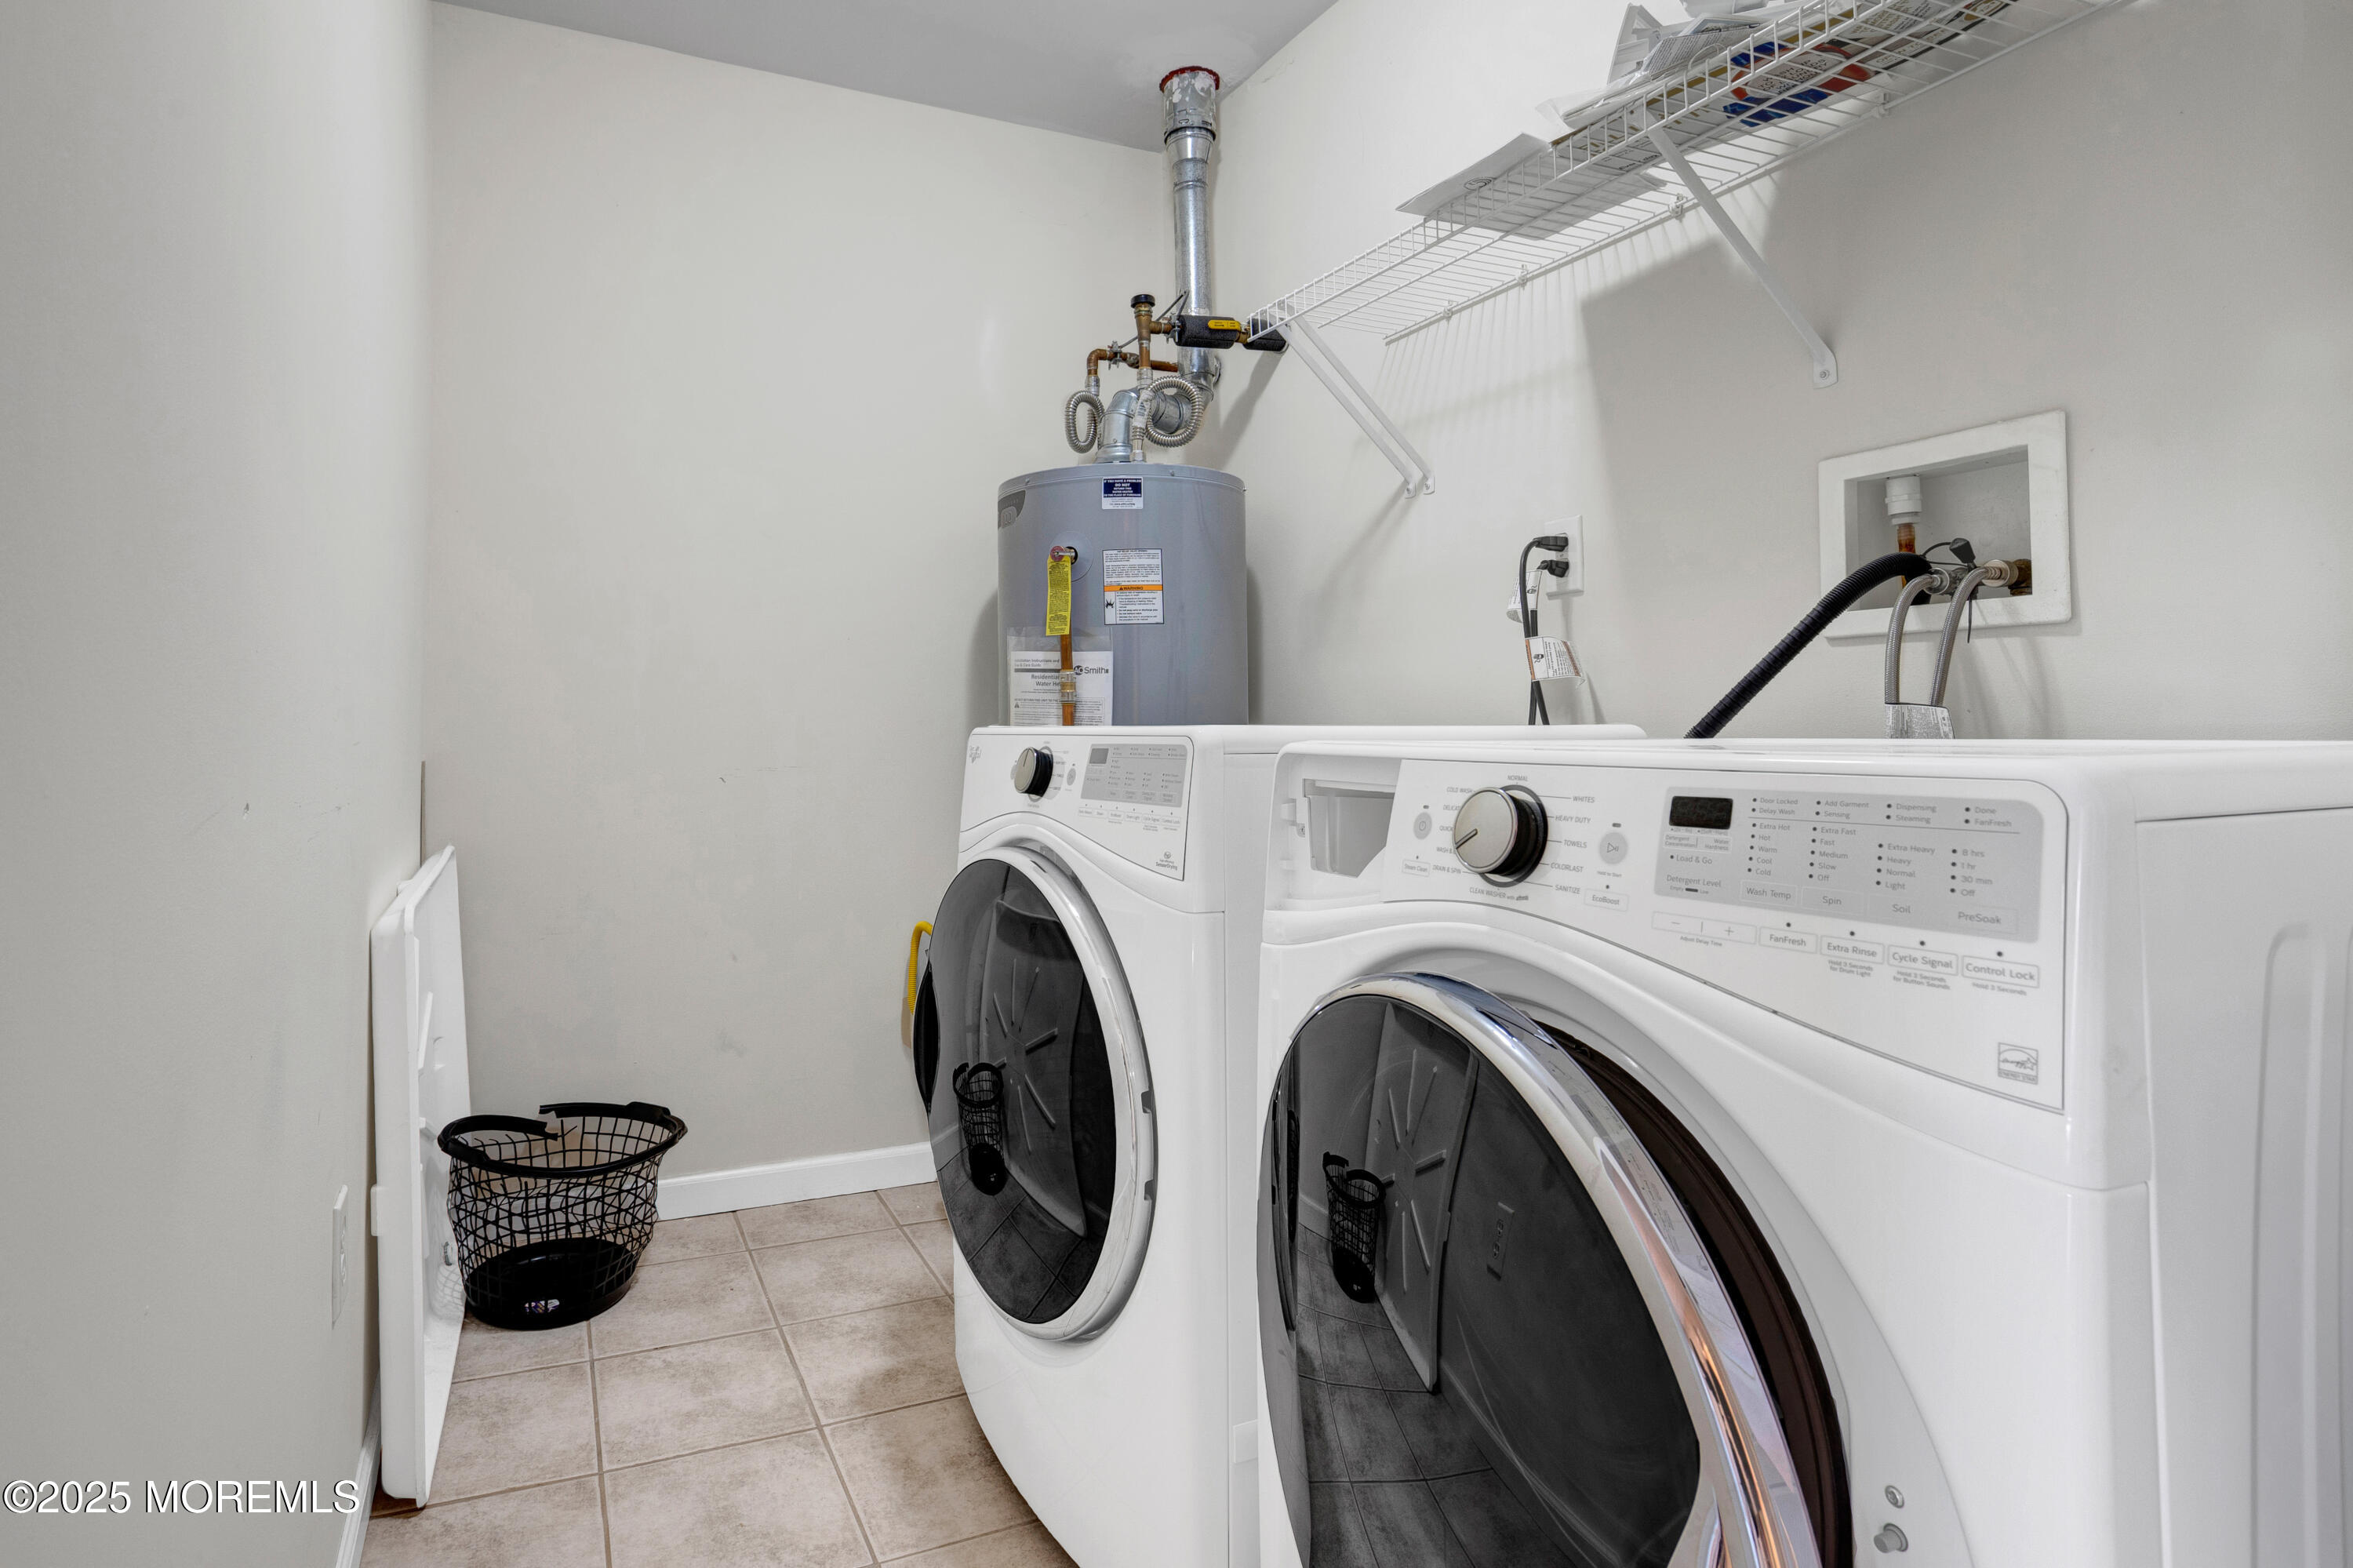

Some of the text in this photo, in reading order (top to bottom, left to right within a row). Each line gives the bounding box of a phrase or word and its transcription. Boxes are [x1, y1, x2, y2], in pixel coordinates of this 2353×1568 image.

[1789, 59, 1826, 75] LODS
[1896, 803, 1937, 813] Dispensing
[1824, 811, 1850, 820] Sensing
[1896, 814, 1931, 824] Steaming
[1974, 818, 2012, 827] FanFresh
[1564, 839, 1587, 849] TOWELS
[1887, 843, 1936, 855] Extra Heavy
[1886, 857, 1912, 866] Heavy
[1551, 862, 1584, 873] COLORLAST
[1886, 868, 1916, 878] Normal
[1667, 875, 1721, 887] Detergent Level
[1885, 881, 1906, 891] Light
[1470, 886, 1485, 895] CLEAN
[1486, 890, 1506, 898] WASHER
[1555, 884, 1580, 894] SANITIZE
[1746, 887, 1791, 900] Wash Temp
[1961, 888, 1976, 897] Off
[1592, 894, 1620, 905] EcoBoost
[1822, 896, 1842, 906] Spin
[1892, 904, 1911, 914] Soil
[1958, 911, 2002, 925] PreSoak
[1769, 933, 1806, 947] FanFresh
[1827, 942, 1877, 957] Extra Rinse
[1892, 952, 1953, 970] Cycle Signal
[1849, 962, 1873, 972] Seconds
[1966, 962, 2036, 981] Control Lock
[1856, 969, 1871, 977] Light
[1919, 973, 1947, 984] Seconds
[1903, 977, 1926, 986] Button
[1926, 981, 1951, 990] Sounds
[1972, 981, 1989, 990] Hold
[1997, 986, 2027, 995] Seconds
